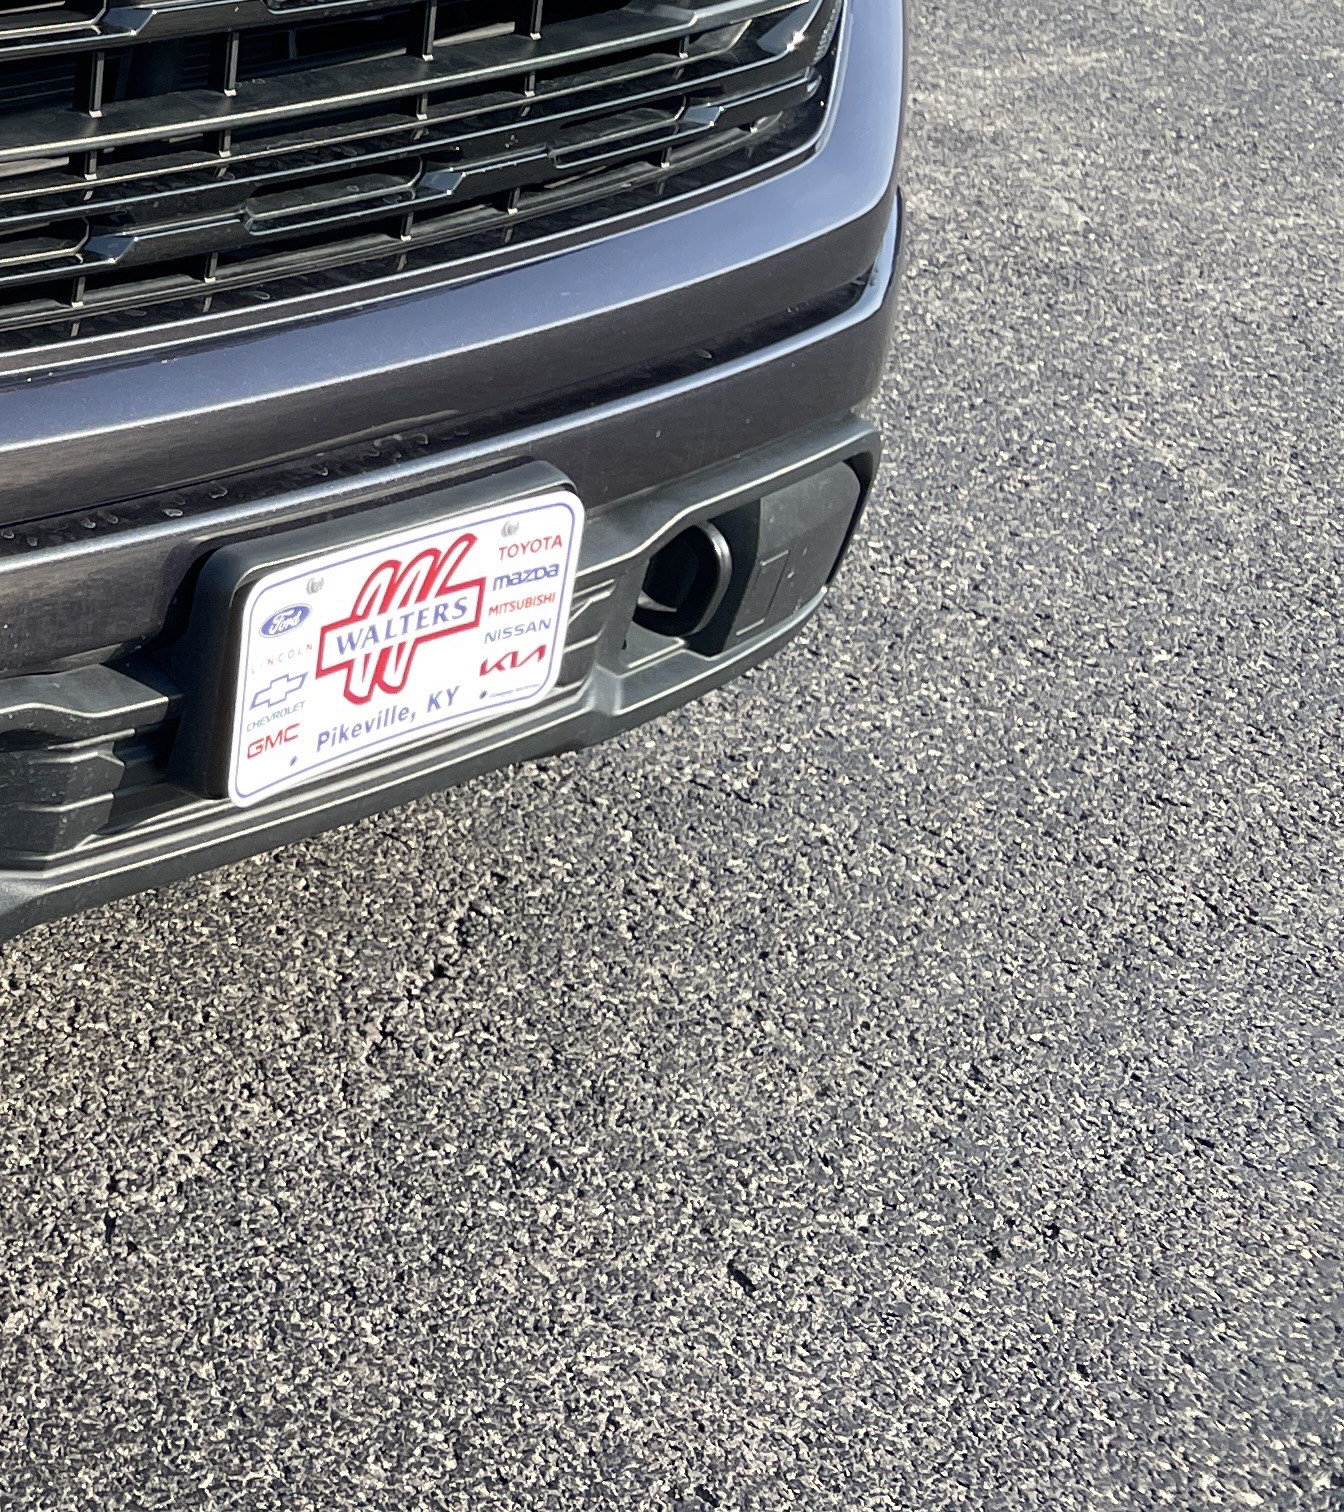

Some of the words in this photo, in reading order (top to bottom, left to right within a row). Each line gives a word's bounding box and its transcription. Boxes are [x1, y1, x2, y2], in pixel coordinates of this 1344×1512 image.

[498, 534, 562, 561] TOYOTA
[488, 592, 556, 616] MITSUBISHI
[336, 596, 468, 655] WALTERS
[484, 618, 552, 644] NISSAN
[251, 643, 313, 675] LINCOLN
[247, 700, 305, 733] CHEVROLET
[316, 704, 416, 752] Pikeville,
[426, 685, 461, 713] KY
[247, 722, 301, 760] GMC
